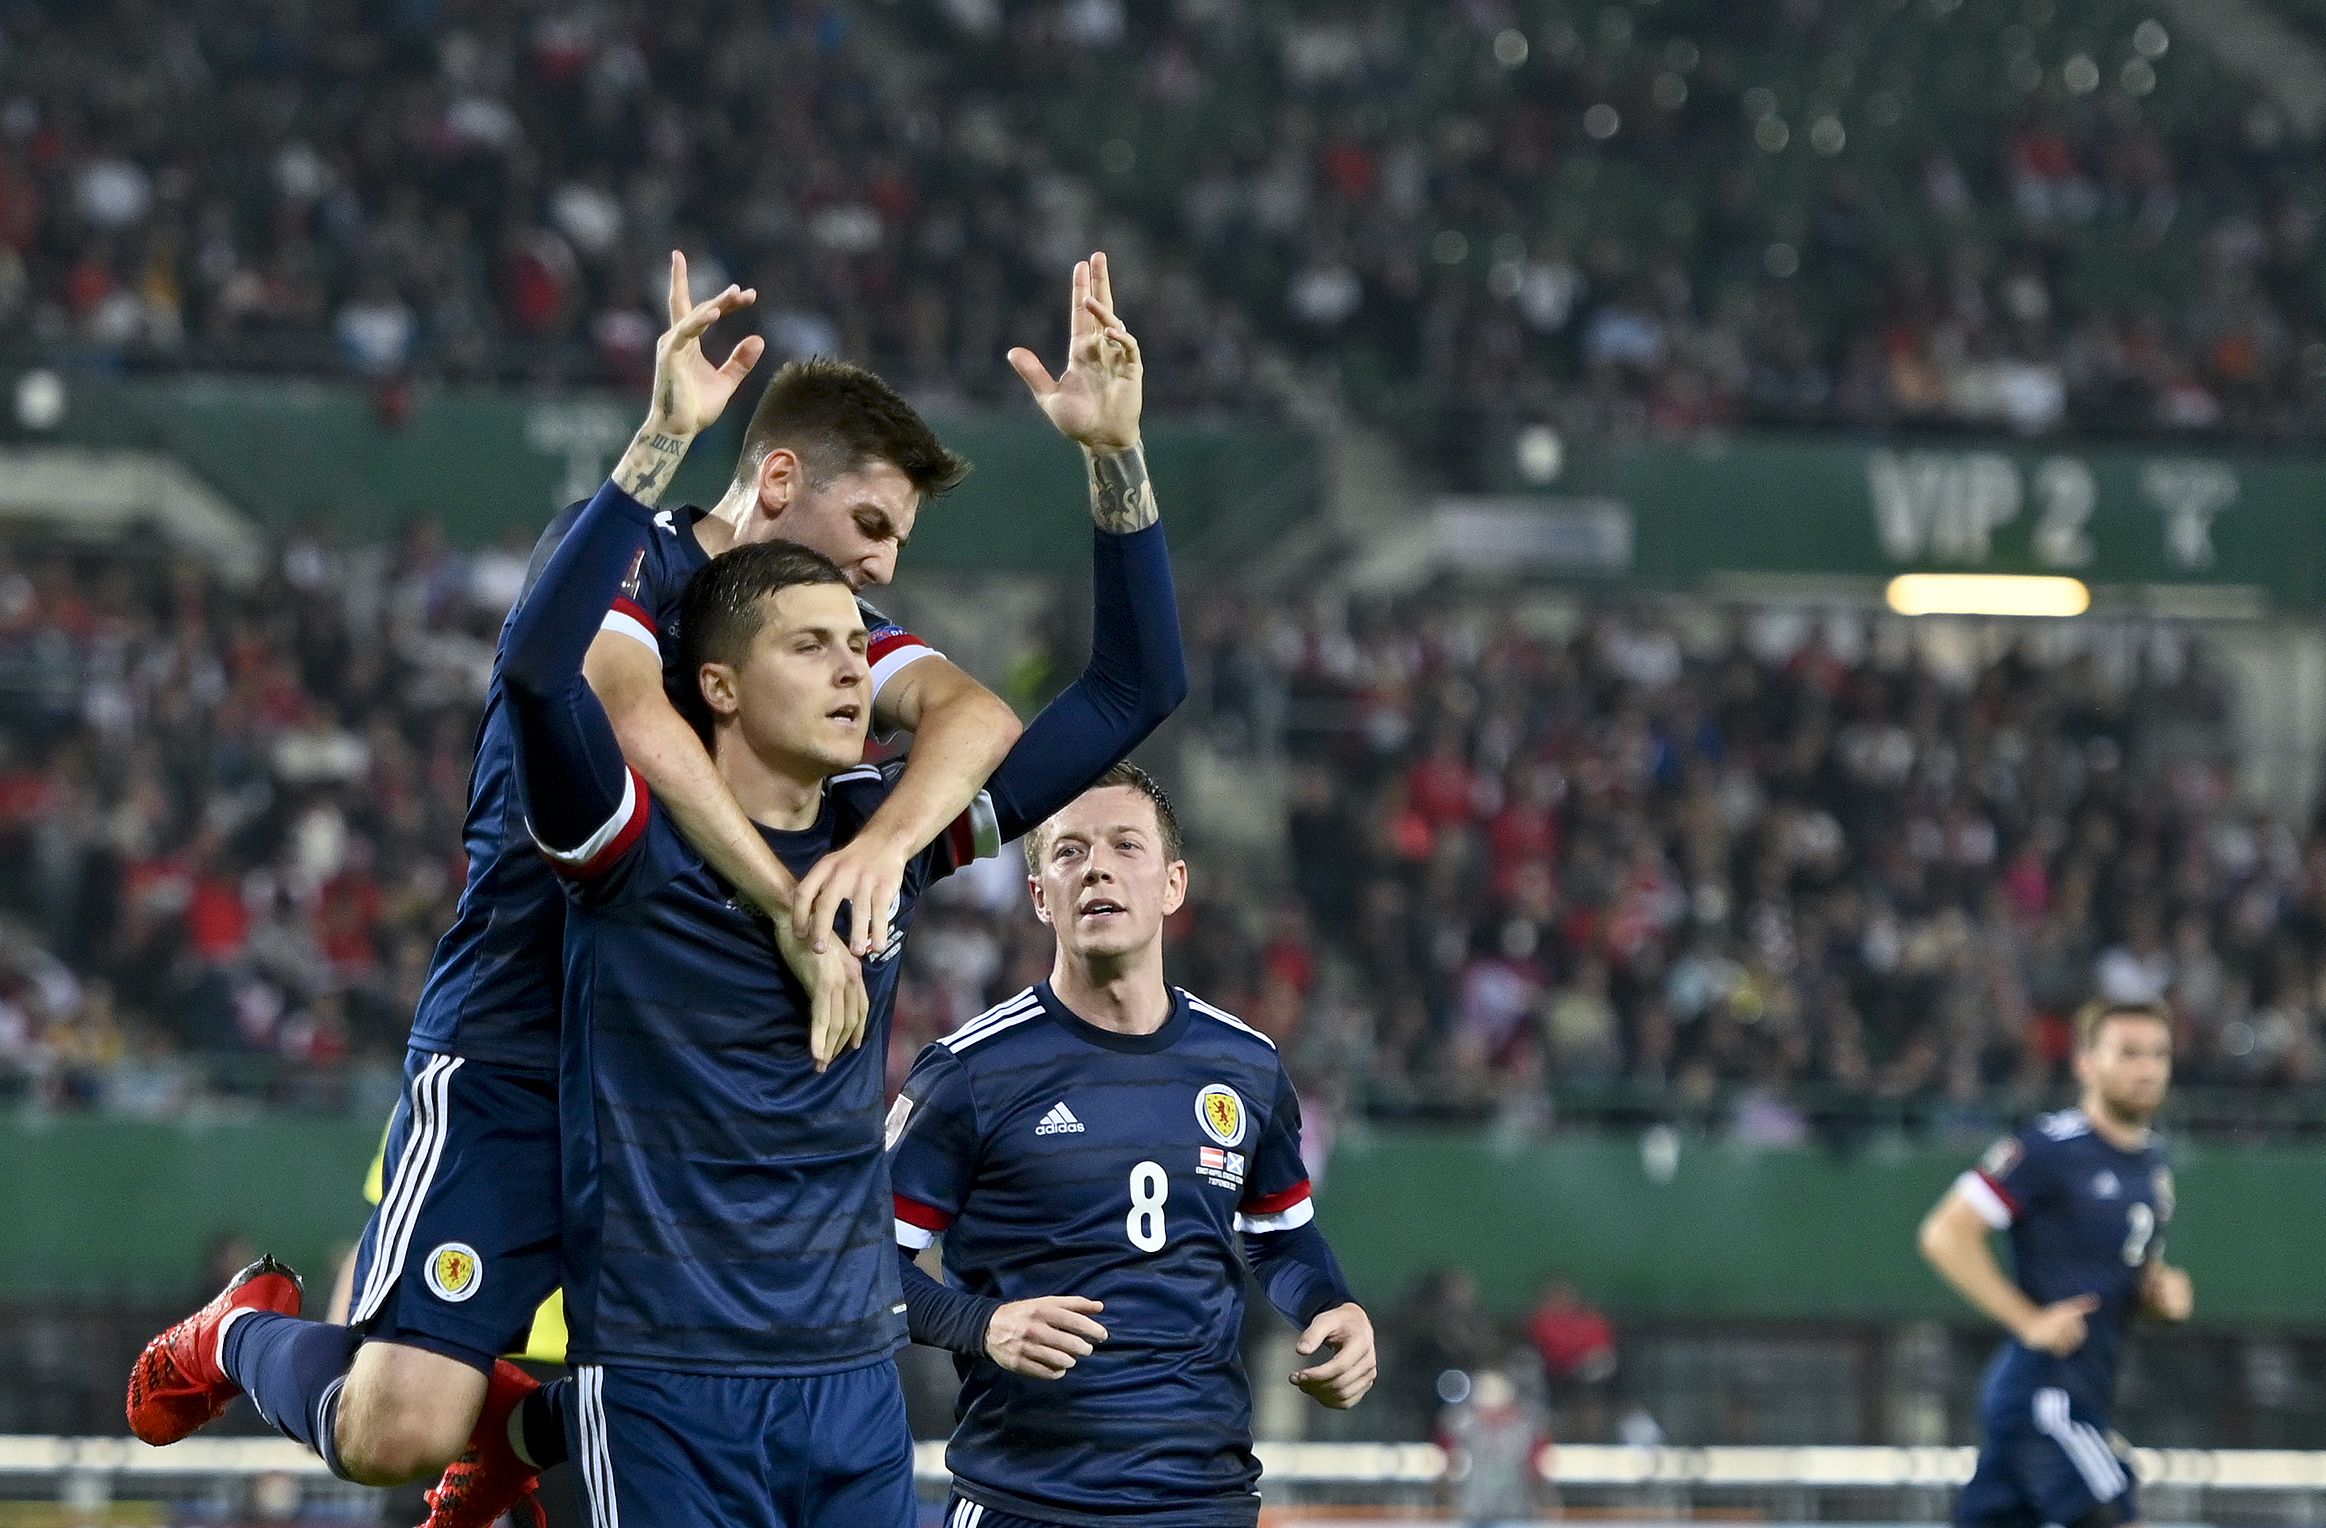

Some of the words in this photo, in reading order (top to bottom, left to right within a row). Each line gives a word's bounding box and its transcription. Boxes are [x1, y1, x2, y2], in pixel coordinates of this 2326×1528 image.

[1867, 448, 2022, 561] VIP
[2034, 455, 2096, 567] 2
[1035, 1122, 1085, 1135] adidas
[1126, 1160, 1168, 1252] 8
